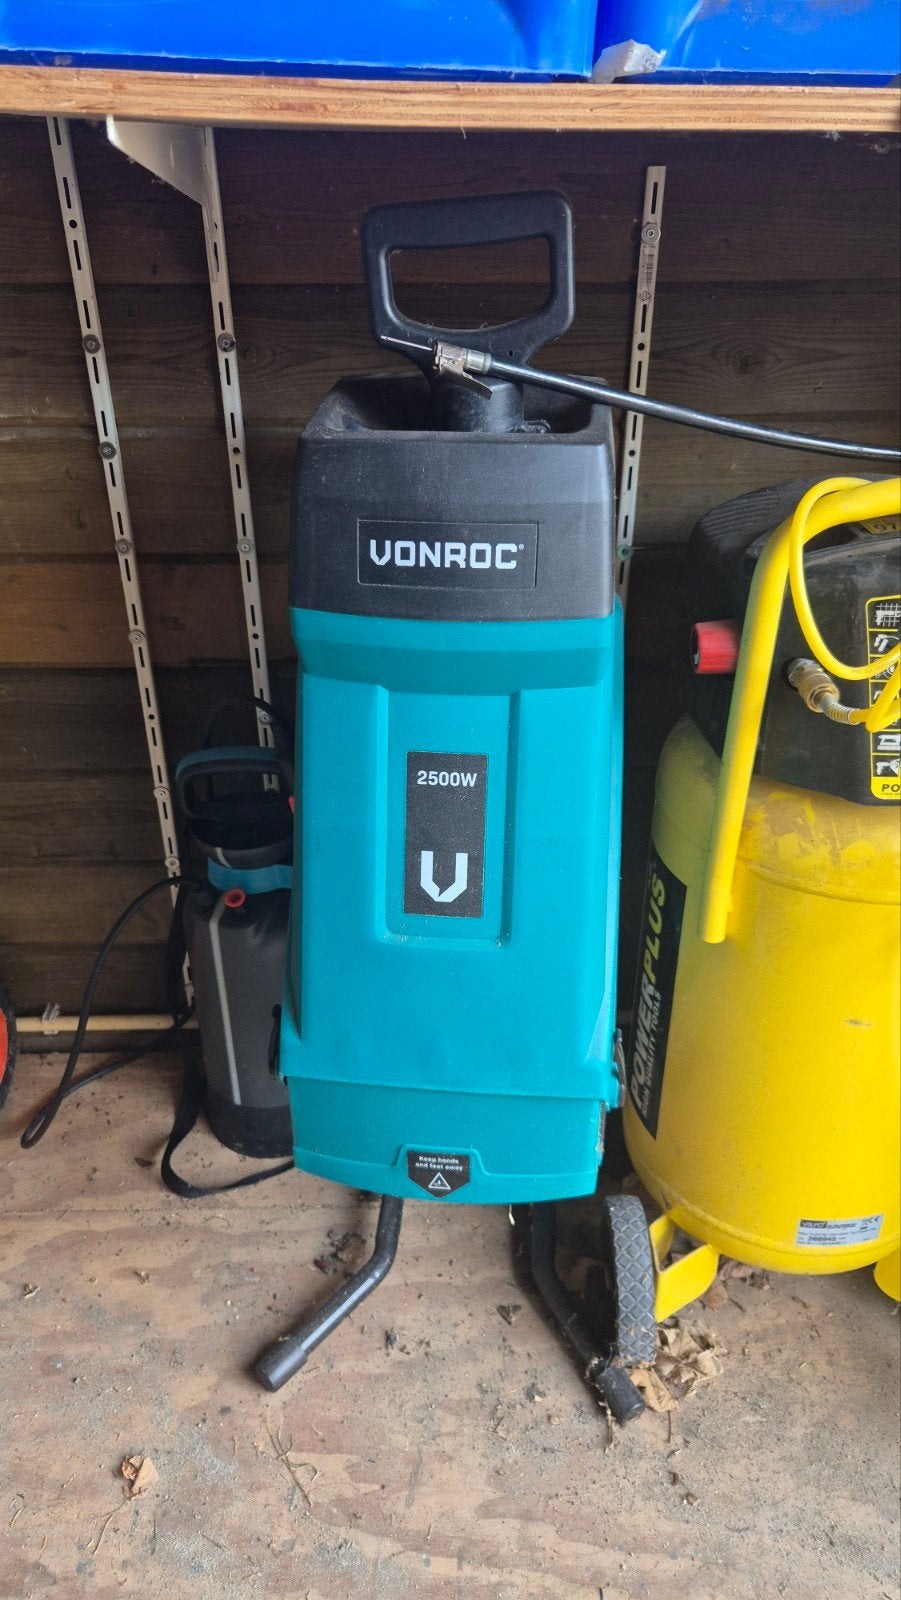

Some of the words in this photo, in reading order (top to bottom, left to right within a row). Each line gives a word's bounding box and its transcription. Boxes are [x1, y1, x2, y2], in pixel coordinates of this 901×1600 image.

[417, 770, 477, 787] 2500W
[631, 872, 665, 1110] POWERPLUS
[650, 989, 662, 1031] TOOLS
